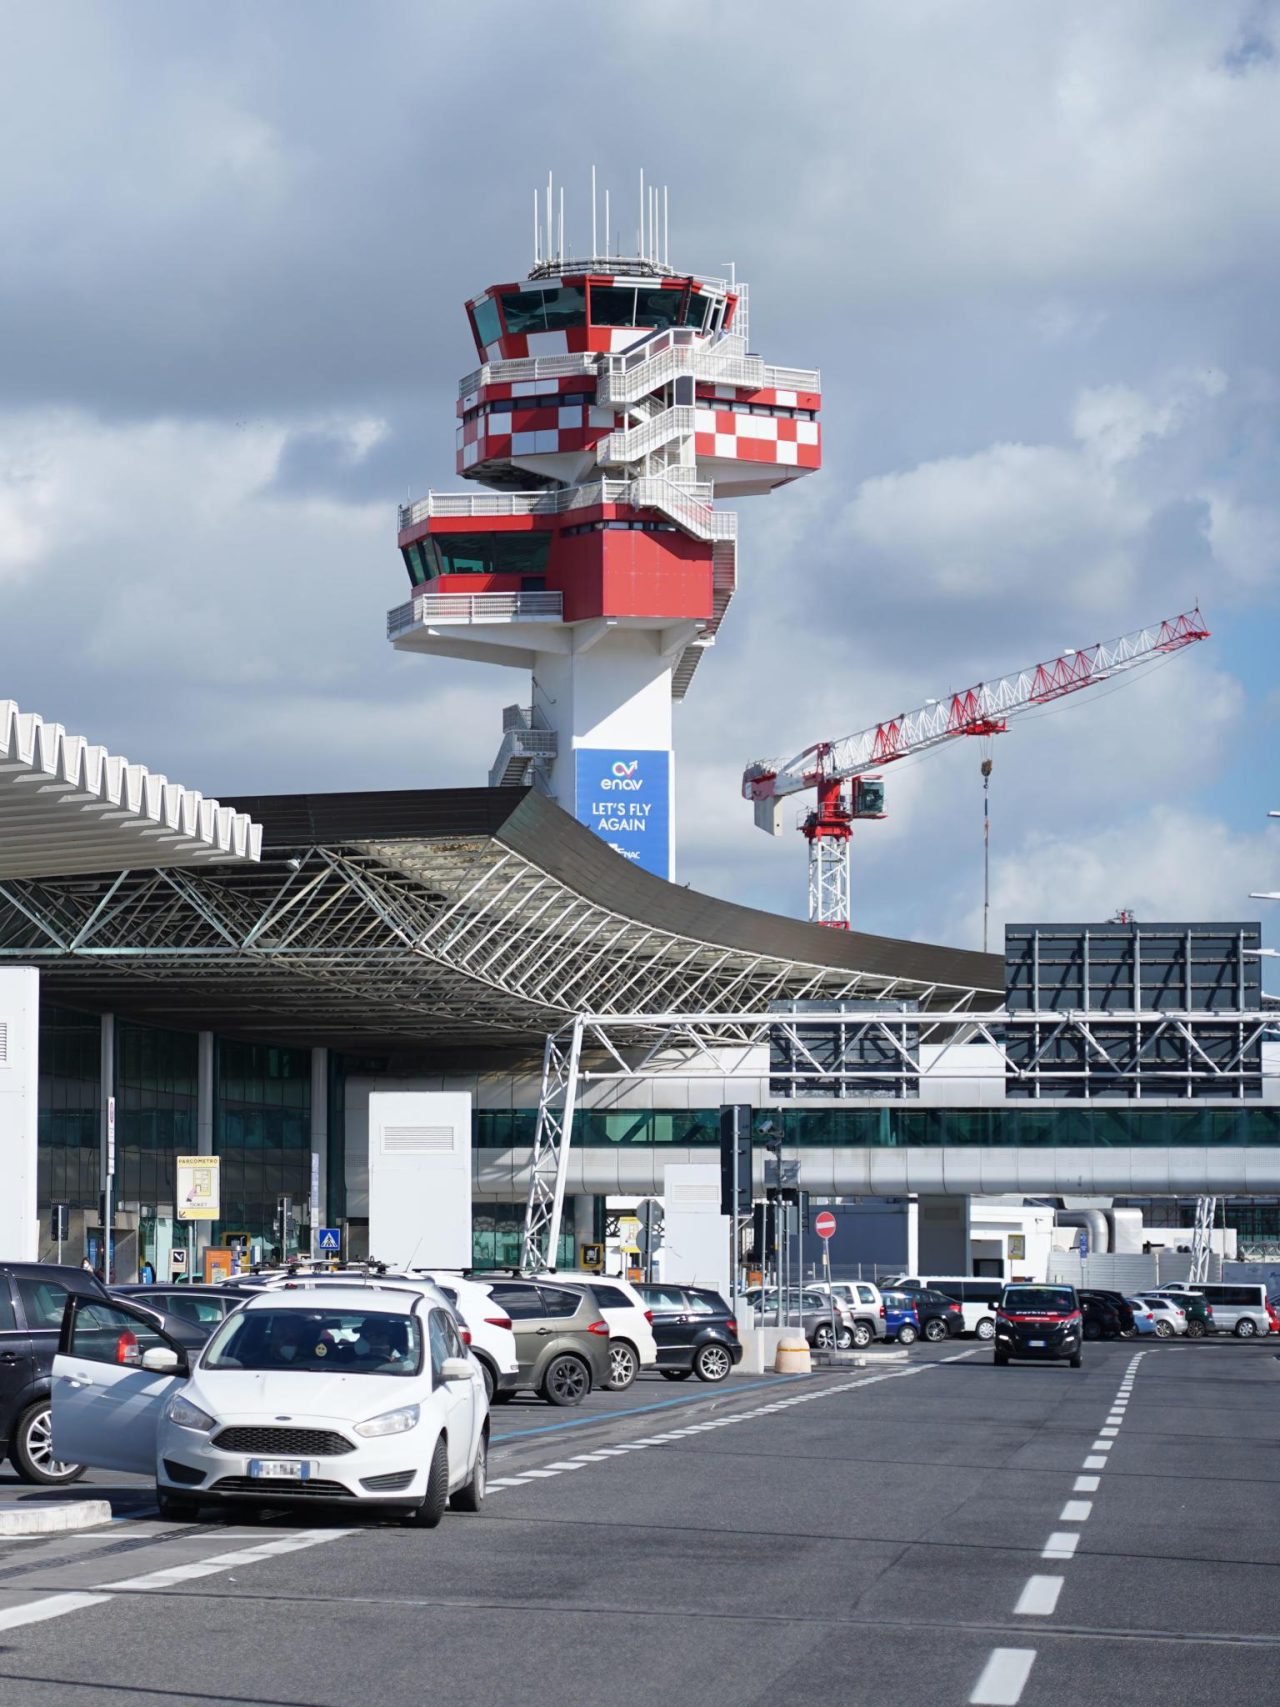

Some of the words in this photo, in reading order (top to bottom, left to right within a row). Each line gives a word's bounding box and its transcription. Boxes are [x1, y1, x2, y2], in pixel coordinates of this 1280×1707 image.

[601, 779, 643, 790] enav
[592, 803, 625, 815] LET'S
[630, 804, 651, 816] FLY
[598, 818, 645, 831] AGAIN
